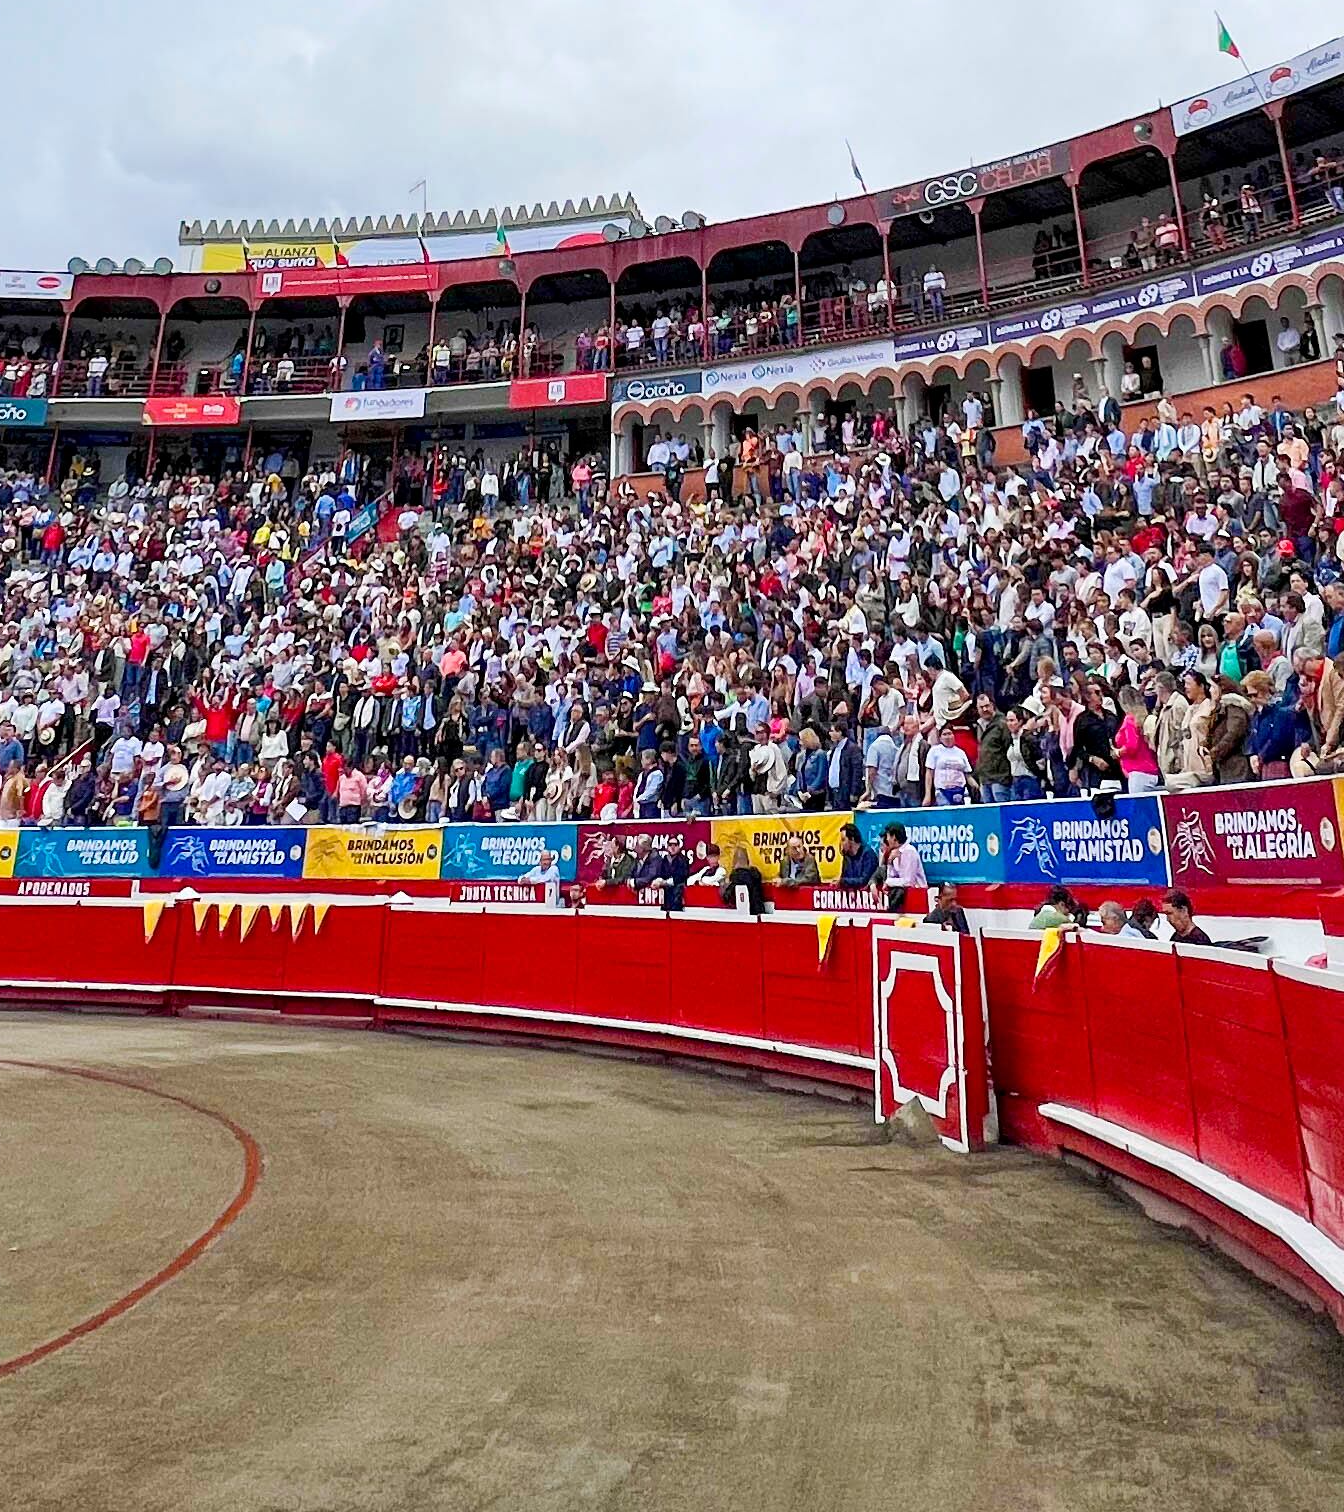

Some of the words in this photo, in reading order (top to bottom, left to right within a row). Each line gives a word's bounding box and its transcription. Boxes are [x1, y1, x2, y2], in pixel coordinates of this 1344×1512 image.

[924, 172, 978, 204] GSC
[265, 246, 317, 258] ALIANZA
[1250, 252, 1273, 278] 69
[1137, 283, 1159, 307] 69
[1040, 308, 1062, 331] 69
[936, 330, 957, 352] 69
[1052, 818, 1130, 841] BRINDAMOS
[1214, 807, 1297, 835] BRINDAMOS
[66, 838, 137, 852] BRINDAMOS
[209, 839, 277, 851] BRINDAMOS
[347, 838, 414, 851] BRINDAMOS
[481, 836, 546, 850] BRINDAMOS
[1244, 824, 1317, 859] ALEGRÍA
[92, 850, 140, 865] SALUD
[226, 850, 286, 865] AMISTAD
[362, 849, 425, 865] INCLUSIÓN
[501, 849, 560, 866] EQUIDD
[933, 839, 980, 864] SALUD
[1076, 838, 1144, 863] AMISTAD
[1232, 847, 1245, 860] LA
[17, 881, 91, 896] APODERADOS
[459, 885, 492, 901] JUNTA
[493, 885, 537, 902] TECNICA
